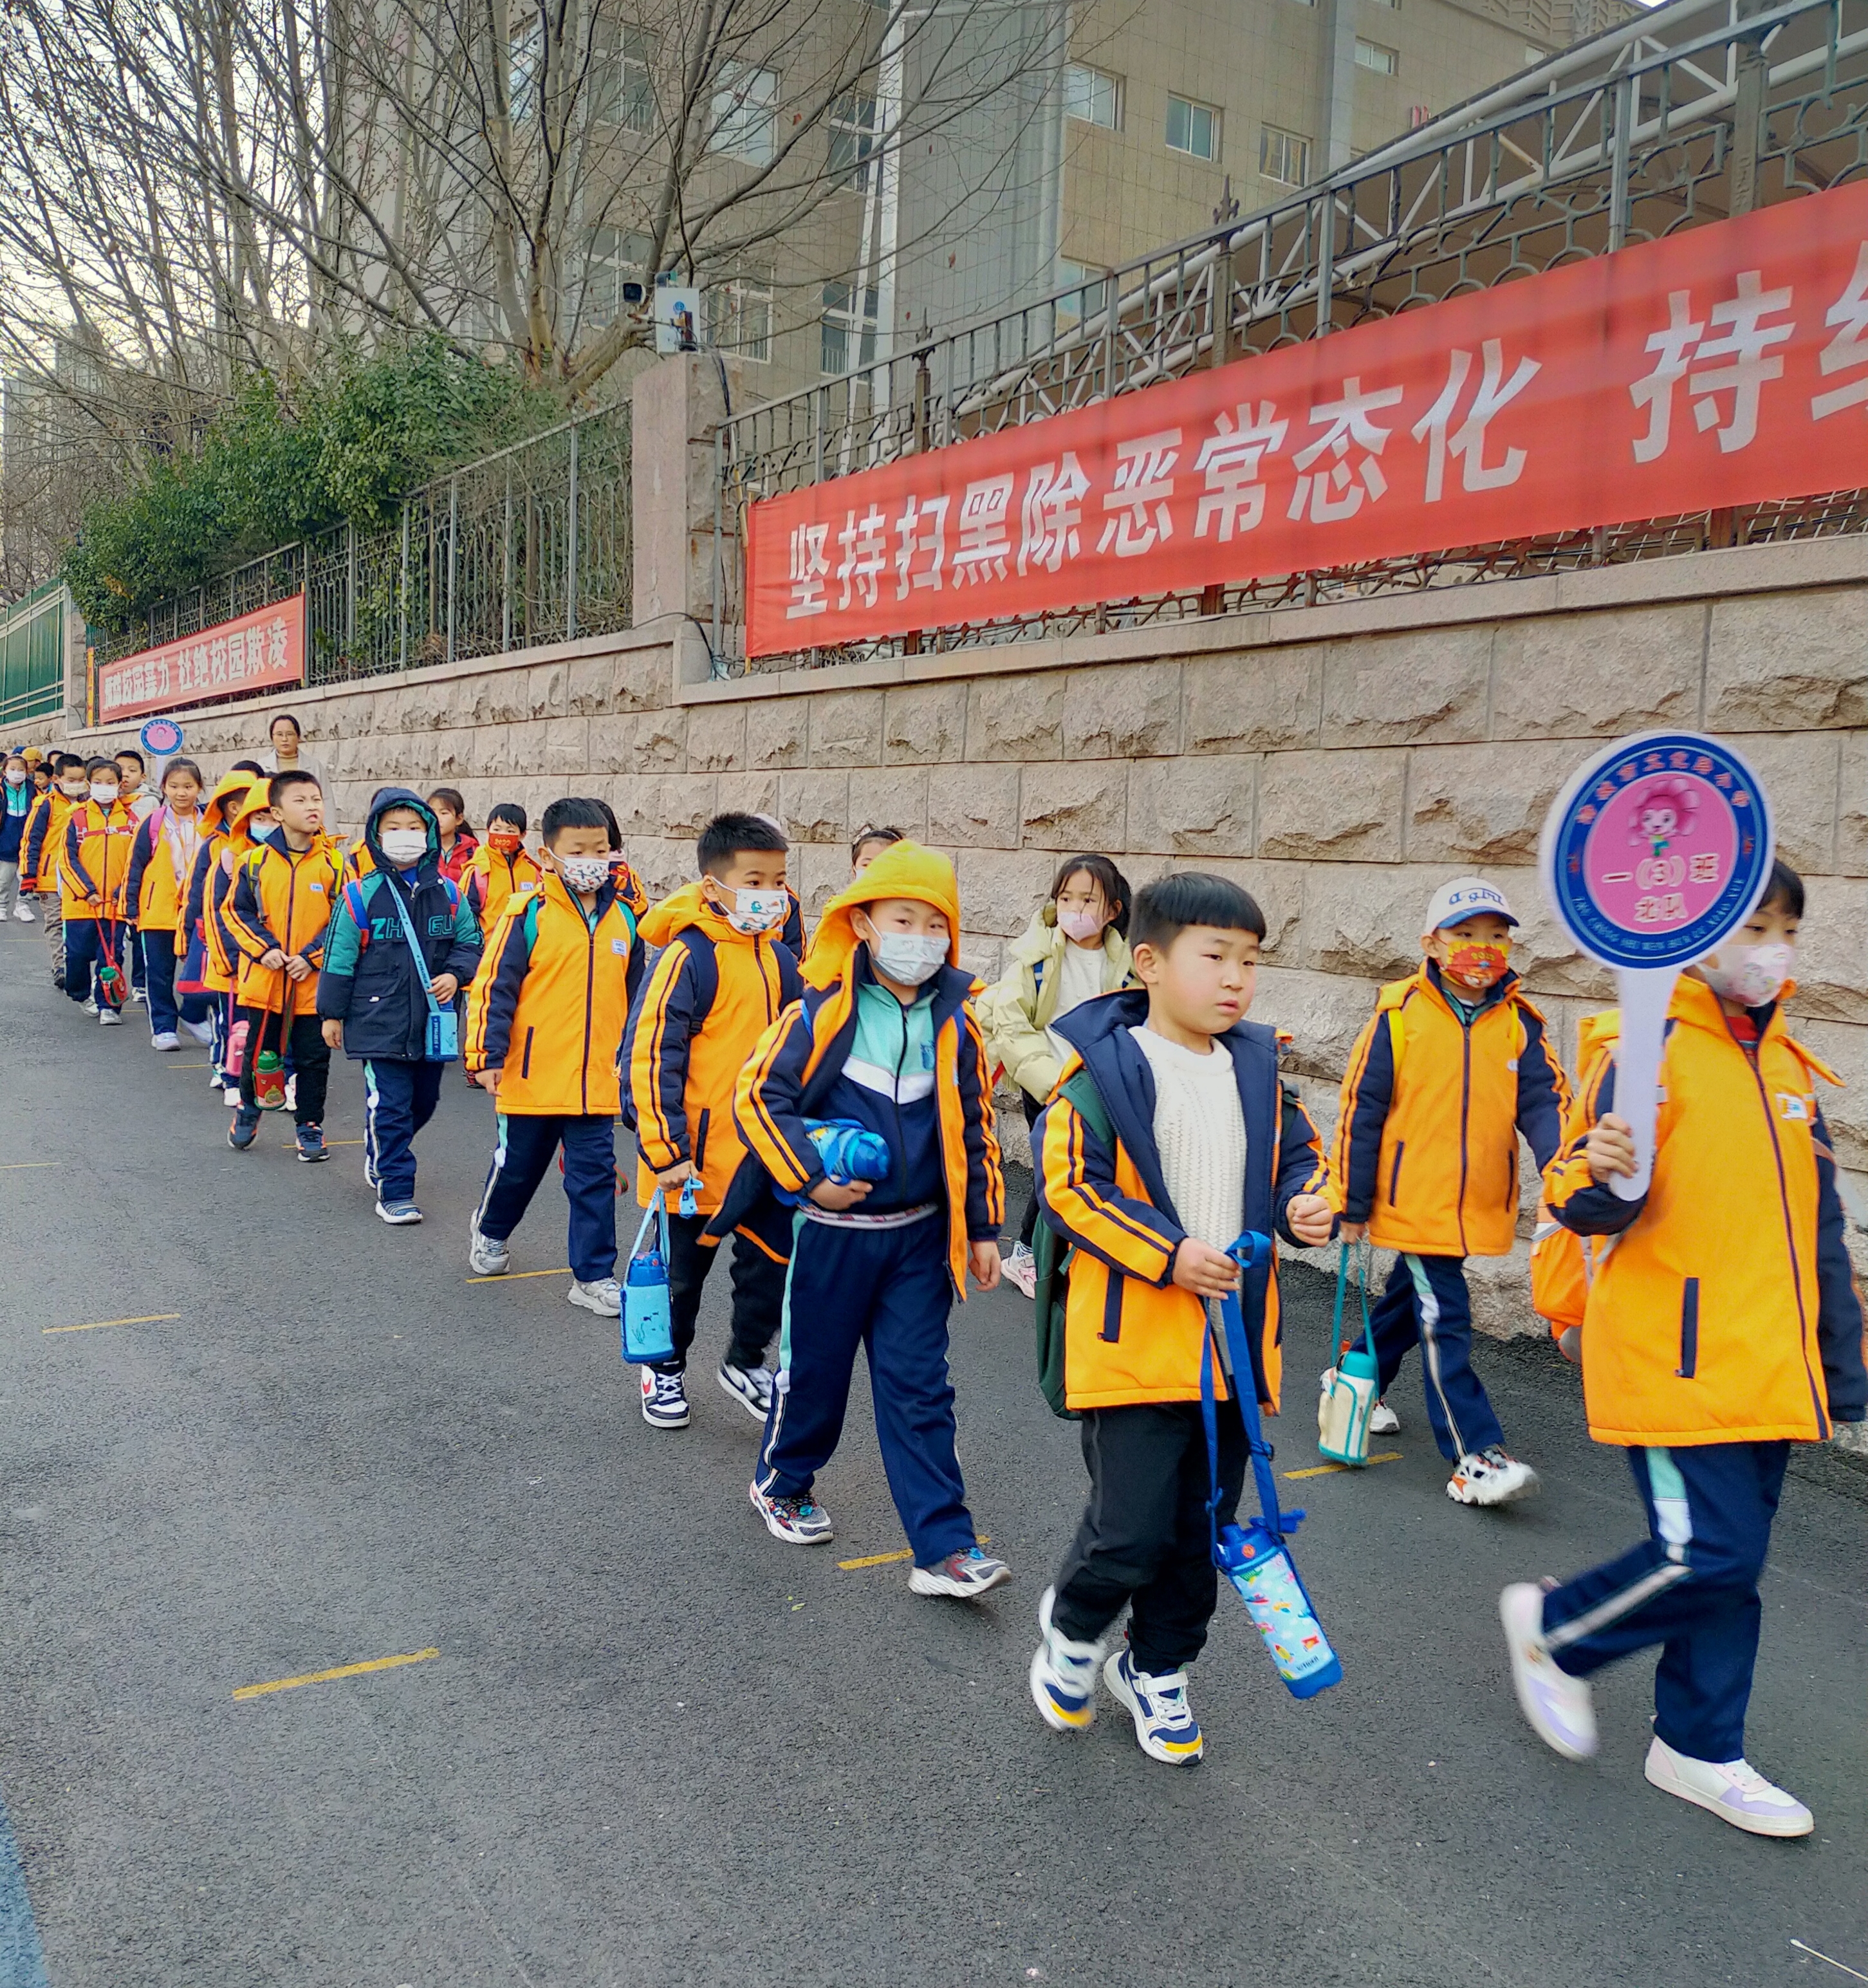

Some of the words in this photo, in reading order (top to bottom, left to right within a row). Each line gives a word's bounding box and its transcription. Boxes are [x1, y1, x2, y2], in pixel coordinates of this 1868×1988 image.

[786, 338, 1542, 620] 坚持扫黑除恶常态化
[104, 658, 170, 711] 校园暴力
